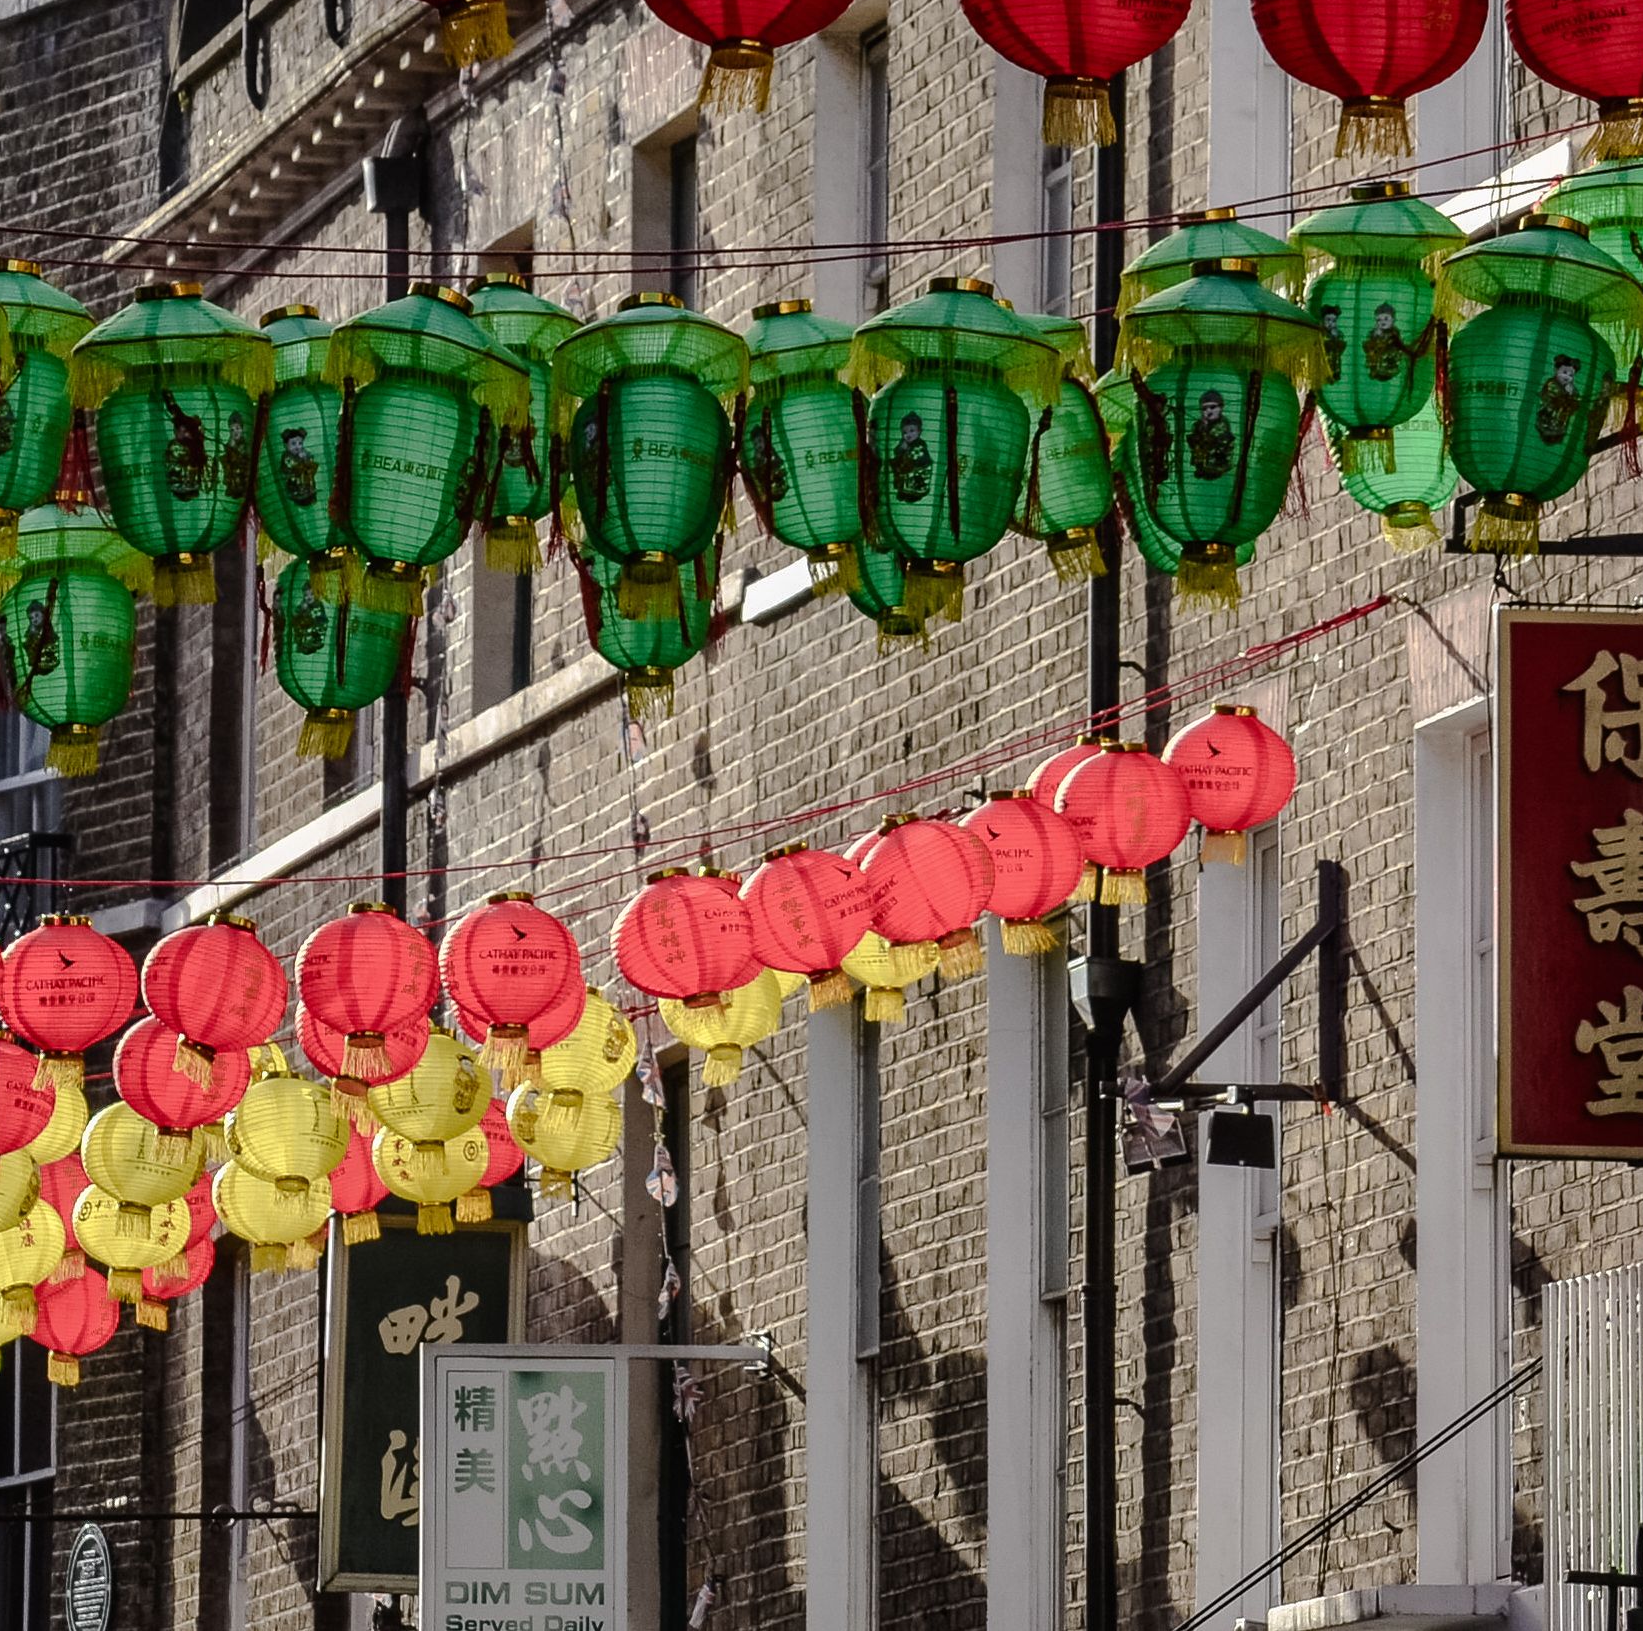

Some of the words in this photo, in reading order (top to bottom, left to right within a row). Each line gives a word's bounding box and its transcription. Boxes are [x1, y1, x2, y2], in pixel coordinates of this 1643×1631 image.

[1541, 5, 1629, 36] HIPPODROME
[648, 442, 679, 459] BEA
[819, 451, 845, 465] BEA
[374, 460, 402, 476] BEA
[1177, 764, 1212, 776] CATHAY
[1214, 766, 1253, 777] PACIFIC
[478, 949, 518, 961] CATHAY
[520, 948, 558, 960] PACIFIC
[26, 979, 67, 992] CATHAY
[67, 975, 106, 989] PACIFIC
[453, 1385, 497, 1494] 精美
[445, 1581, 510, 1605] DIM
[524, 1581, 605, 1605] SUM
